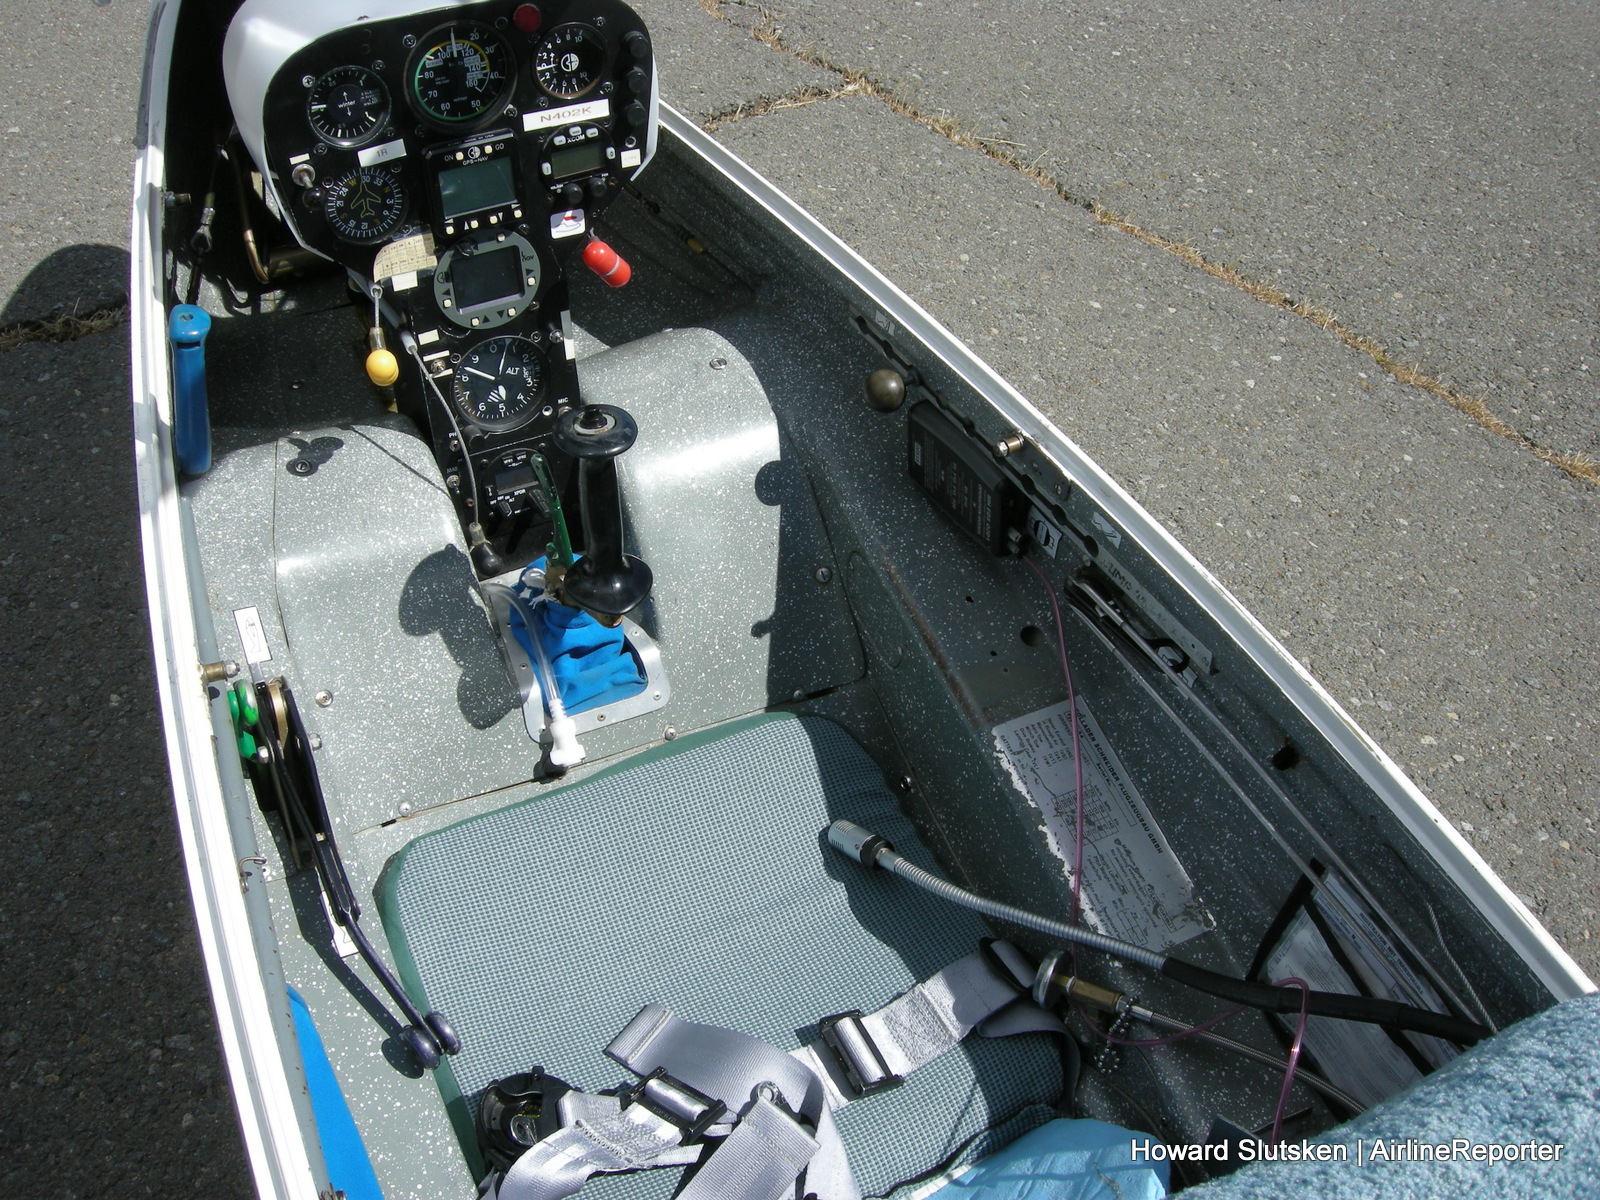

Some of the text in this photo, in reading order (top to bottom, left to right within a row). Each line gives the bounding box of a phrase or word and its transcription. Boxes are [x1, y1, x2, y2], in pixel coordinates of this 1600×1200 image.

[461, 48, 474, 57] 120
[485, 46, 494, 54] 30
[437, 51, 451, 59] 100
[469, 64, 481, 72] 140
[428, 90, 438, 98] 70
[338, 100, 356, 109] winter
[441, 102, 450, 111] 60
[471, 100, 480, 108] 50
[540, 106, 592, 122] N402K
[567, 134, 585, 143] XCOM
[376, 148, 388, 158] 1R
[463, 156, 488, 166] GPS-NAV
[348, 179, 357, 187] W
[362, 175, 371, 183] 30
[373, 177, 383, 186] 33
[339, 187, 348, 197] 24
[348, 219, 357, 228] 15
[489, 344, 497, 353] 0
[472, 354, 479, 363] 9
[522, 353, 529, 362] 2
[505, 367, 520, 375] ALT
[461, 373, 469, 382] 8
[526, 377, 533, 387] 3
[463, 391, 470, 400] 7
[516, 393, 525, 401] 4
[478, 402, 486, 411] 6
[499, 403, 505, 412] 5
[1046, 717, 1056, 730] Never
[1056, 713, 1073, 736] AIRSPEED
[1024, 725, 1035, 739] Winch
[1030, 723, 1044, 743] Aero Tow
[1043, 724, 1055, 739] Rough
[1093, 742, 1120, 782] SCHNEIDER
[1117, 782, 1151, 832] FLUGZEUGBAU
[1360, 912, 1388, 946] REGISTRATION
